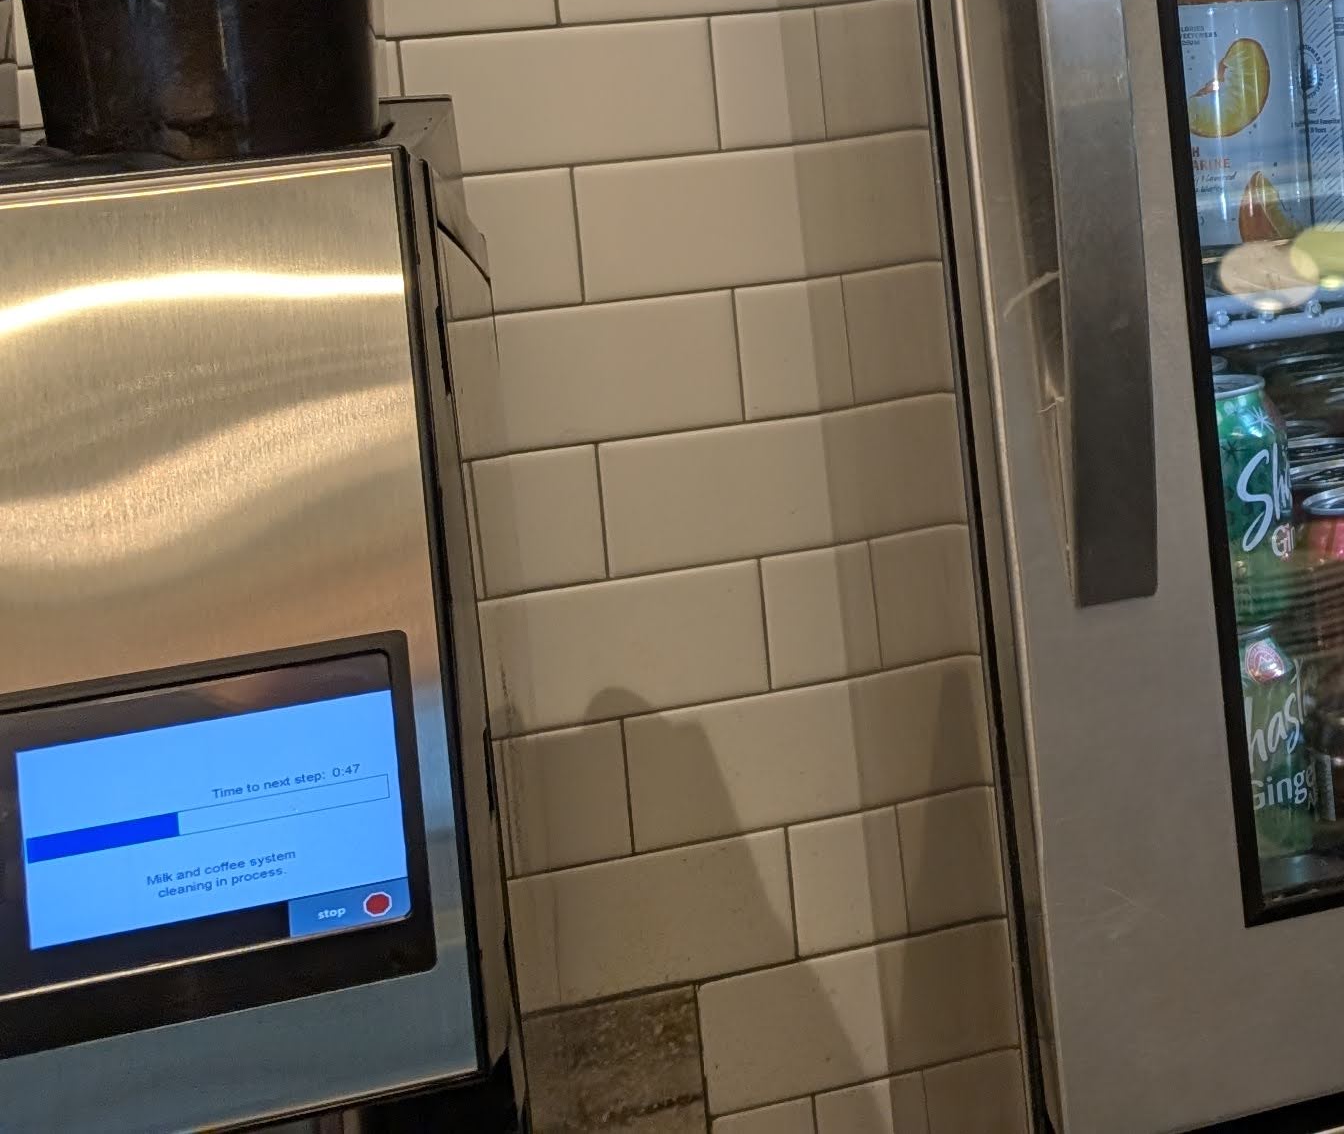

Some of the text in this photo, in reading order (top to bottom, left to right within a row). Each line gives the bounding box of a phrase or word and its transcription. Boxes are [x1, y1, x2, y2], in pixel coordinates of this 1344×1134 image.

[212, 764, 360, 799] Time to next step: 0:47
[147, 850, 296, 886] Milk and coffee system
[158, 868, 287, 898] cleaning in process.
[317, 907, 346, 920] stop
